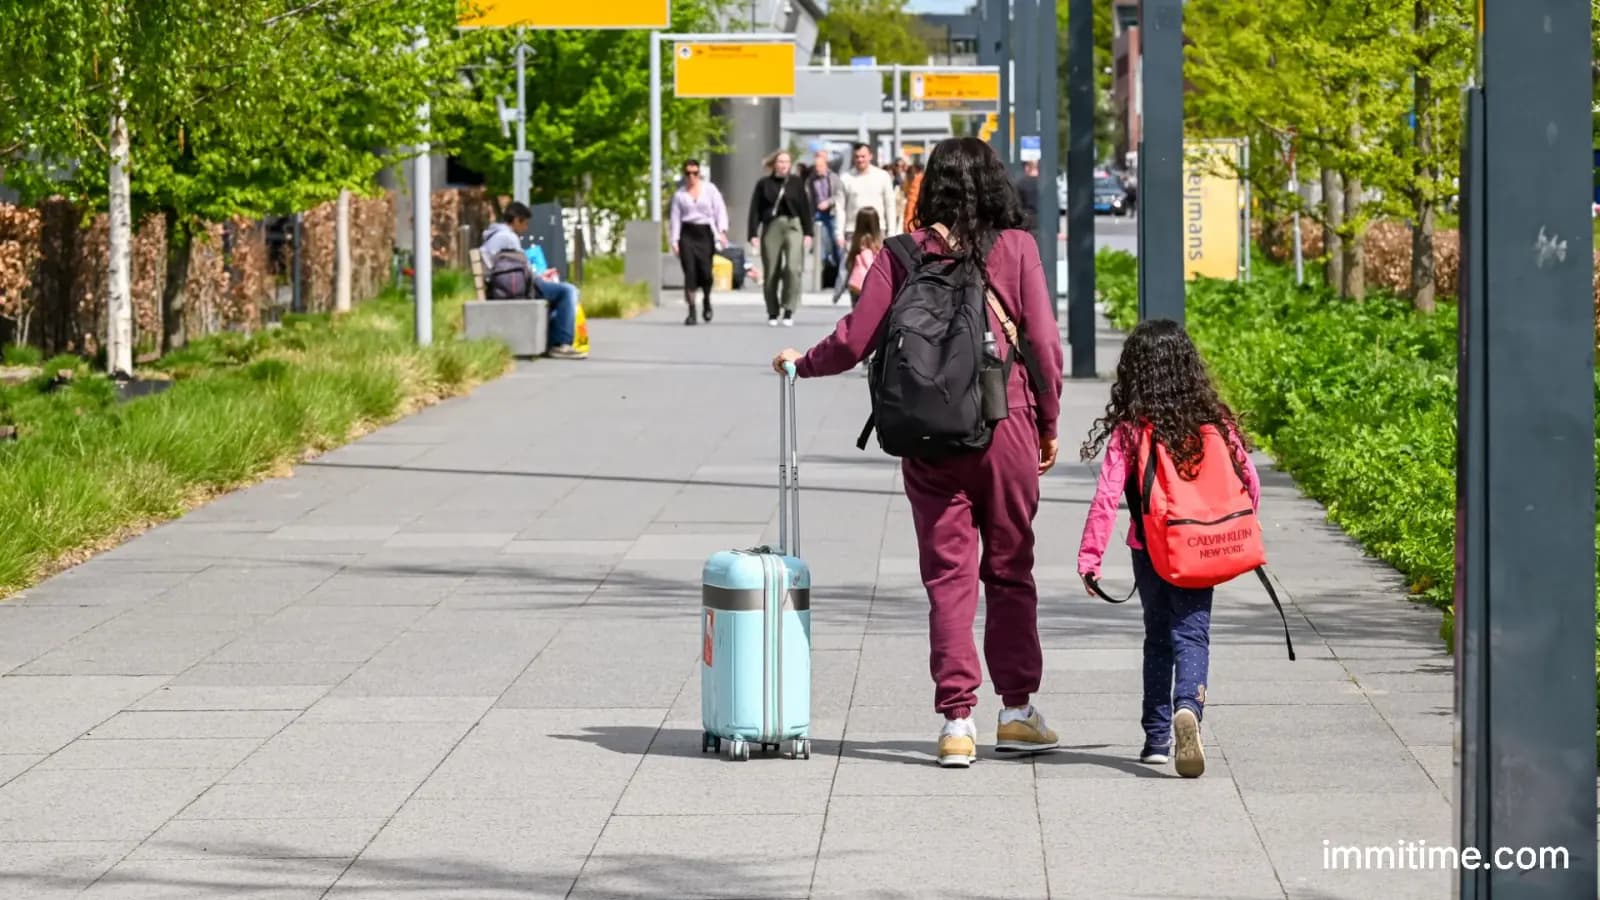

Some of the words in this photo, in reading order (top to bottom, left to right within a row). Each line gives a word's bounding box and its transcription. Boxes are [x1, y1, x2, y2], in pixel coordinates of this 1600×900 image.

[1183, 164, 1204, 261] eijmans
[1187, 533, 1226, 548] CALVIN
[1227, 528, 1252, 542] KLEIN
[1200, 548, 1221, 559] NEW
[1222, 544, 1245, 555] YORK
